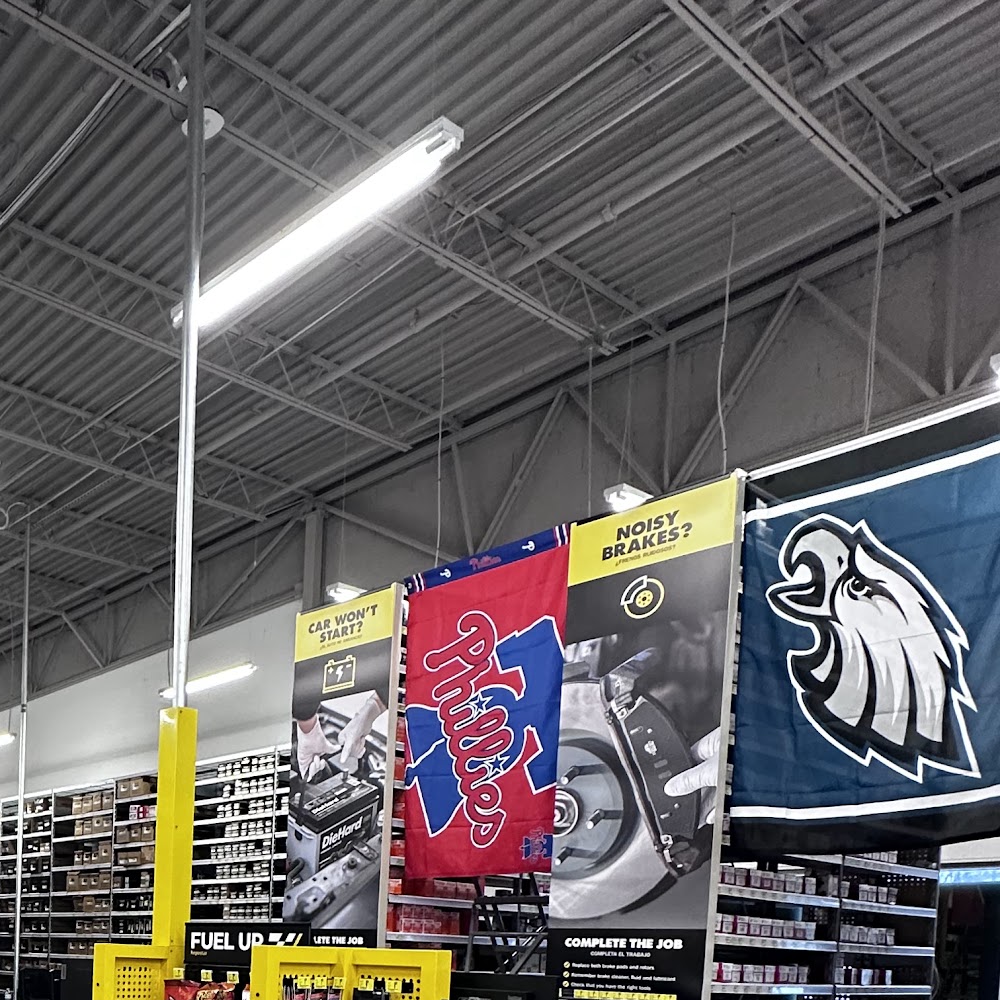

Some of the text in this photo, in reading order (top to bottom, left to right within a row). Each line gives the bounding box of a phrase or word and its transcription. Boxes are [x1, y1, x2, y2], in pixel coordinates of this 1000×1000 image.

[617, 510, 680, 541] NOISY
[602, 522, 693, 561] BRAKES?
[308, 604, 378, 634] CAR WON'T
[320, 621, 363, 643] START?
[424, 610, 514, 848] Phillies
[322, 816, 363, 850] DieHard
[190, 932, 264, 950] FUEL UP
[347, 937, 363, 945] JOB
[565, 938, 683, 950] COMPLETE THE JOB
